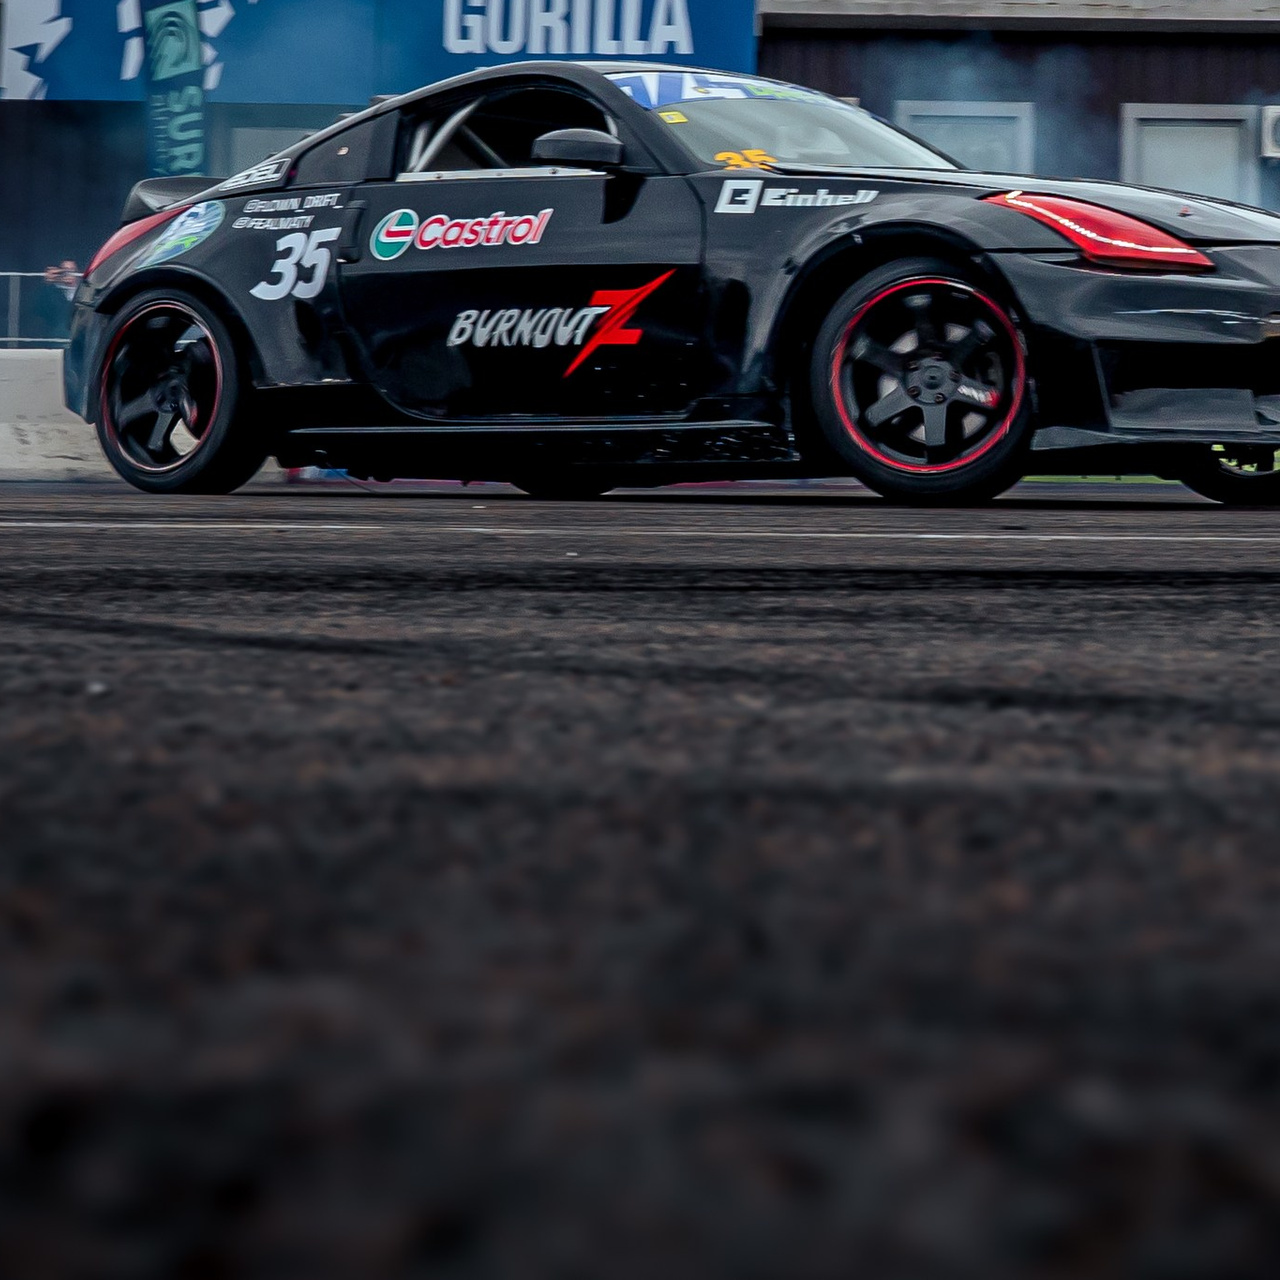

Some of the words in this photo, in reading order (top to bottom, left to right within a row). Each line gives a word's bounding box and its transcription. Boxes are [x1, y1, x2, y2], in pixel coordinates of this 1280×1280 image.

[167, 85, 204, 177] SUR
[714, 149, 778, 170] 35
[760, 188, 879, 207] Einhell
[414, 208, 554, 249] Castrol
[250, 227, 342, 300] 35
[446, 306, 611, 348] BURNOUT
